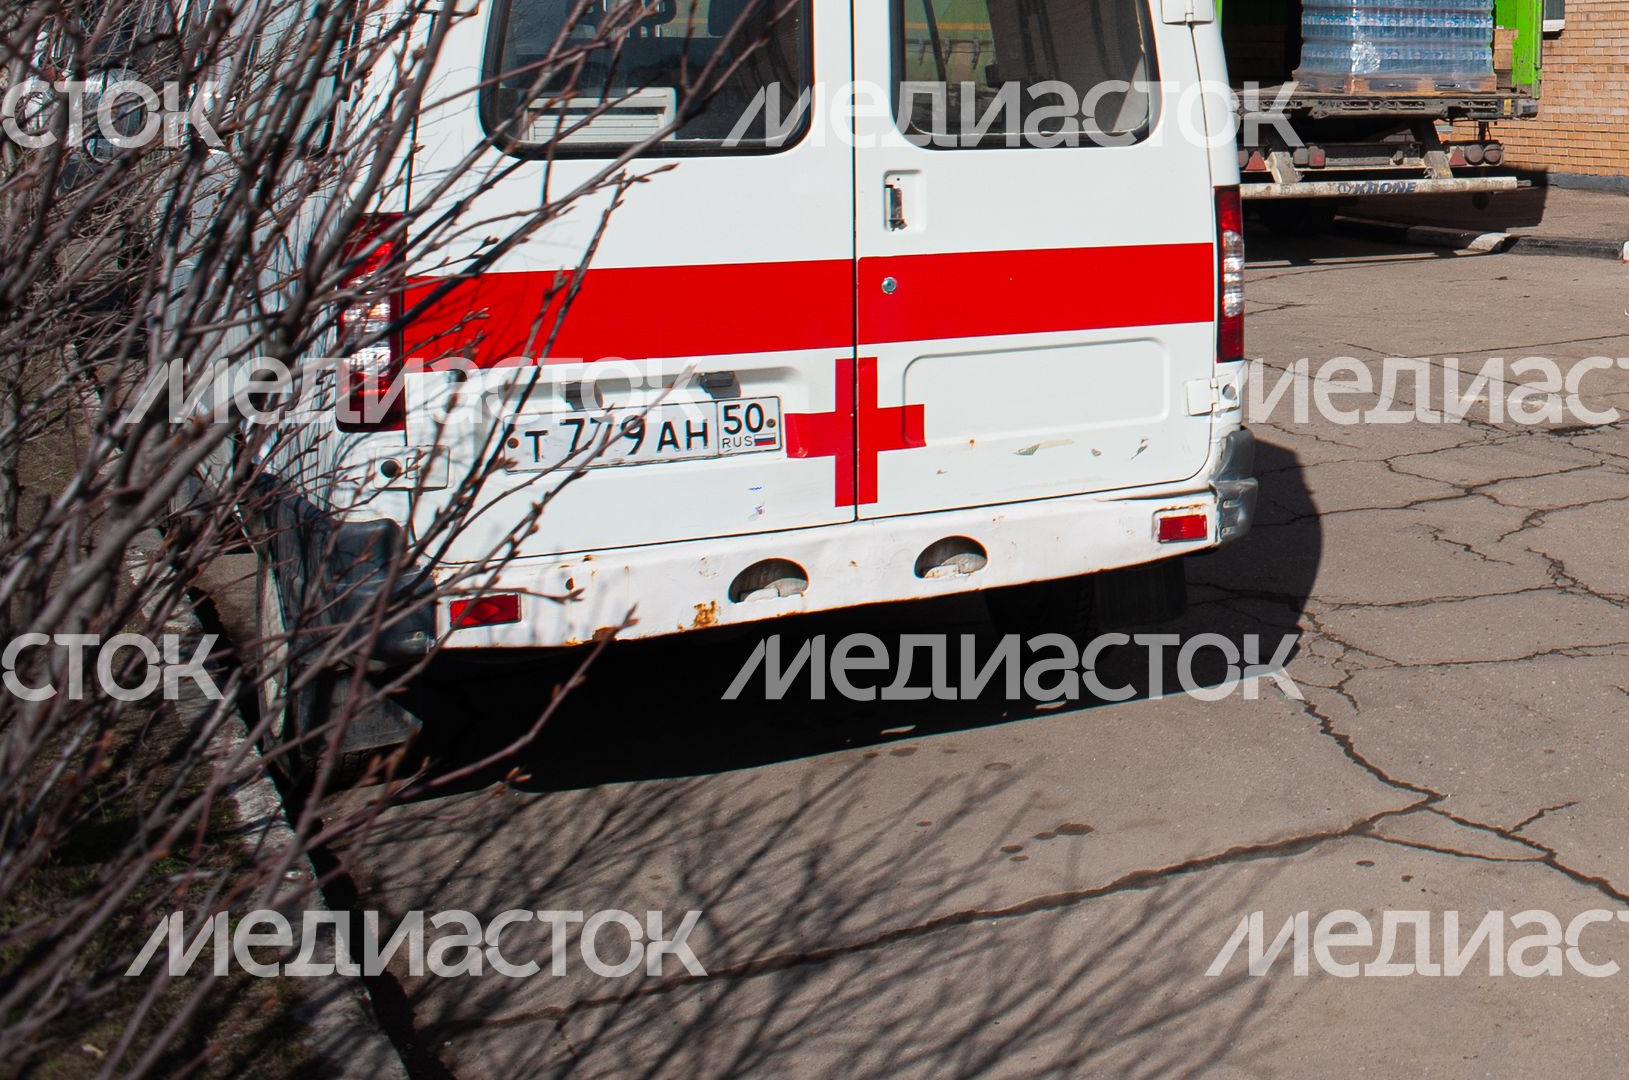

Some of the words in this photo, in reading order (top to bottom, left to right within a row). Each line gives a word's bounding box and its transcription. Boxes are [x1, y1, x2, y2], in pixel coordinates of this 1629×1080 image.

[1354, 182, 1416, 194] KRONE
[723, 402, 765, 435] 50
[722, 435, 753, 449] RUS
